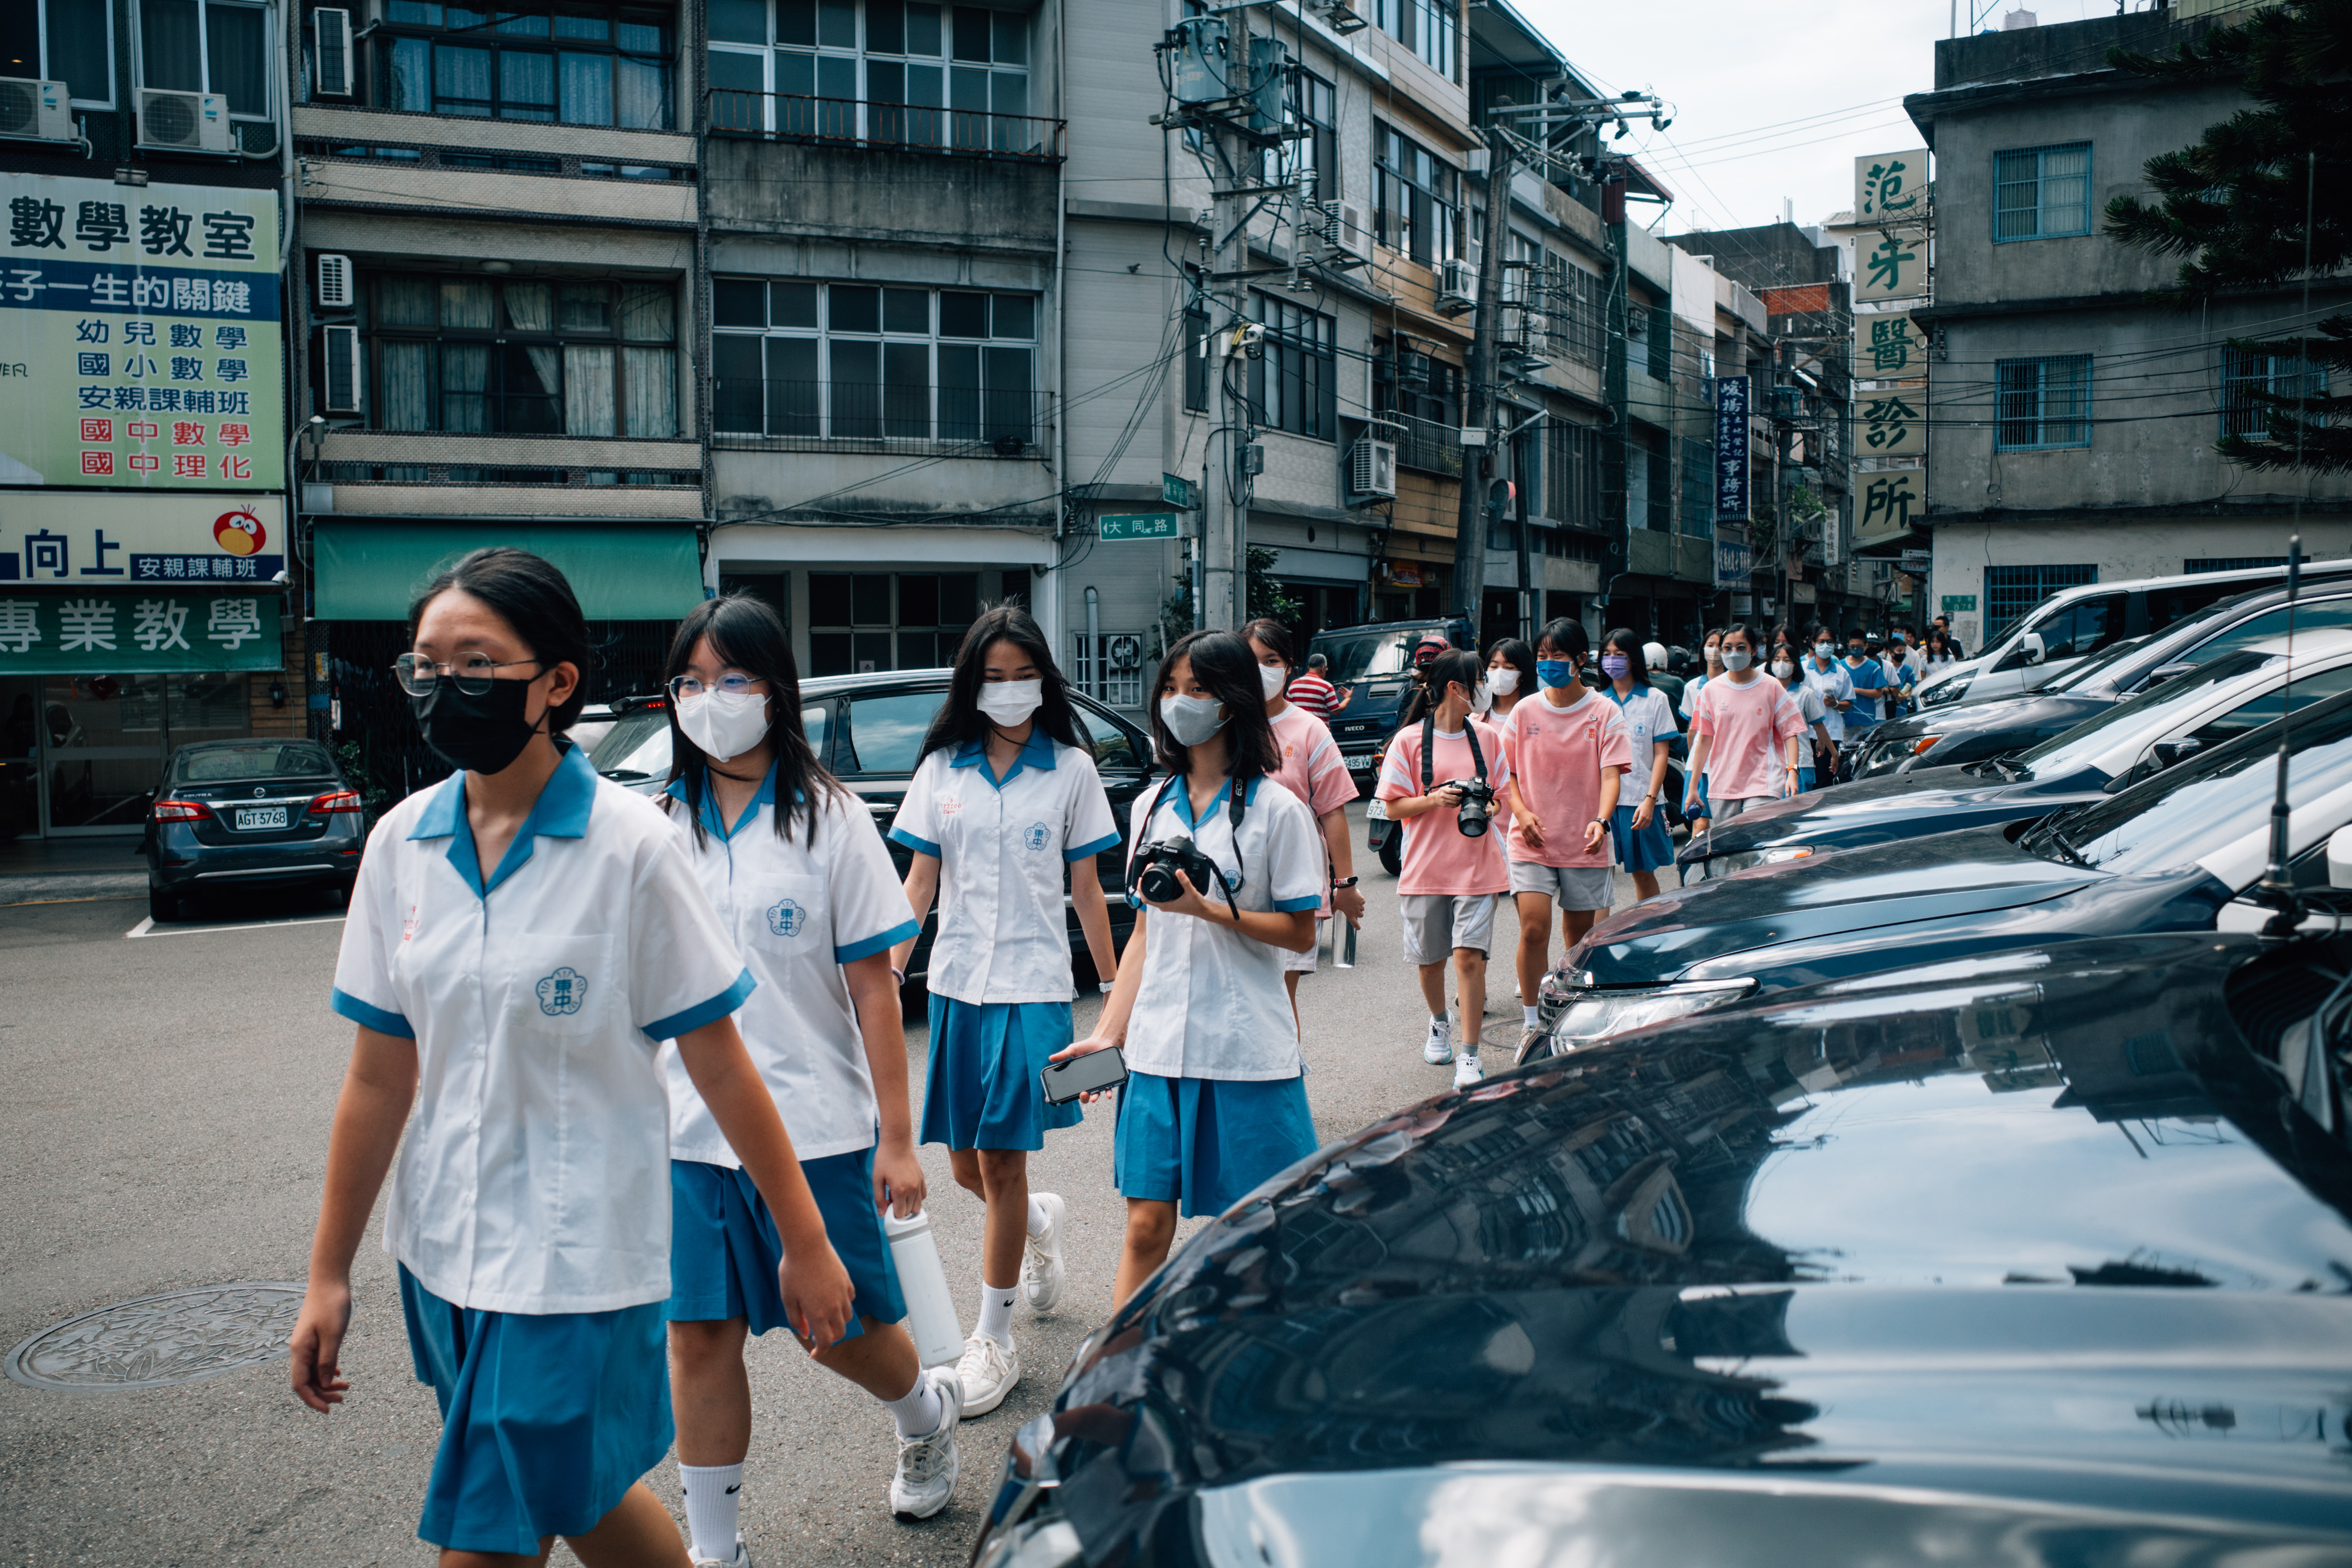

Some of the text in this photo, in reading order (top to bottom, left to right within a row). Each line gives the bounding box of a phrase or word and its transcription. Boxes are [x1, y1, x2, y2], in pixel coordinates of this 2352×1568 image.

[9, 195, 255, 260] 數學教室
[0, 269, 251, 313] 子一生的關鍵
[76, 319, 247, 350] 幼兒數學
[1862, 161, 1919, 529] 范牙醫診所
[78, 353, 248, 382] 國小數學
[78, 385, 250, 414] 安親課輔班
[81, 418, 250, 447] 國中數學
[82, 451, 251, 480] 國中理化
[1109, 519, 1168, 534] 大同路
[25, 529, 124, 579] 向上
[138, 557, 257, 578] 安親課輔班
[0, 598, 260, 652] 專業教學
[1034, 830, 1044, 845] 東中
[1150, 880, 1161, 892] Canon
[780, 908, 794, 931] 東中
[554, 979, 572, 1008] 東中
